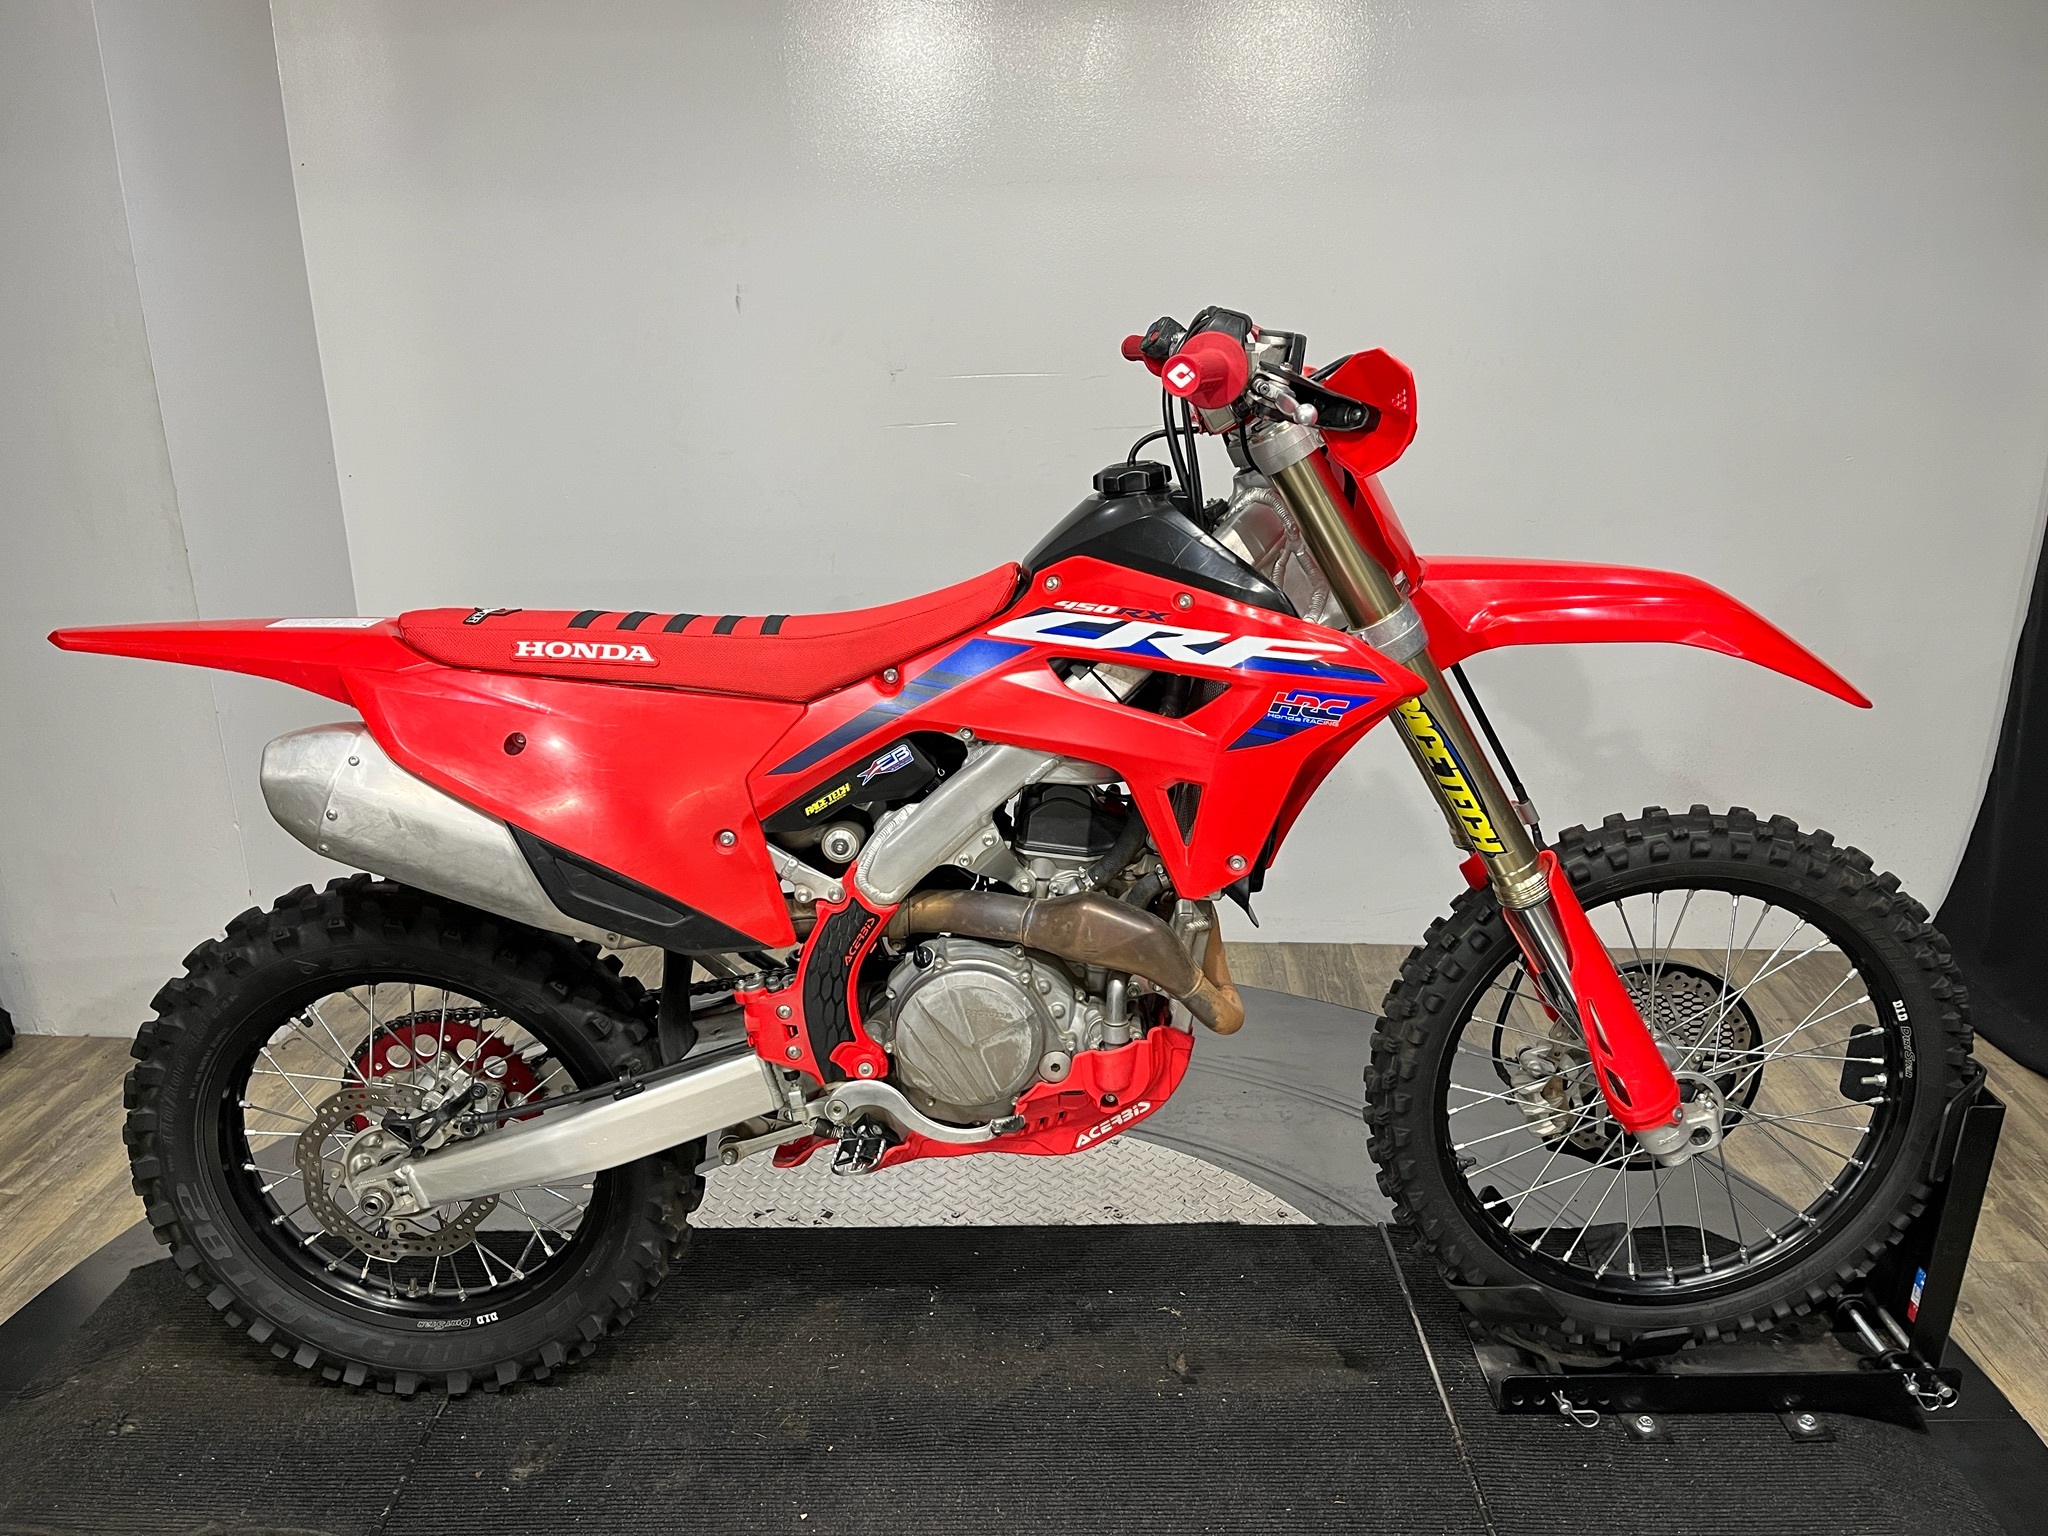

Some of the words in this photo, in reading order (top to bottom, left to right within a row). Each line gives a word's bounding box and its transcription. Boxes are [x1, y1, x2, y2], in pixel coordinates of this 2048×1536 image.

[1054, 600, 1171, 622] 450RX
[515, 640, 655, 663] HONDA
[986, 611, 1350, 668] CRF
[1267, 712, 1302, 723] Honda
[1302, 717, 1340, 728] RACING
[1268, 691, 1350, 723] HRC
[844, 917, 876, 967] ACERBIS
[1075, 1101, 1151, 1149] ACERBIS
